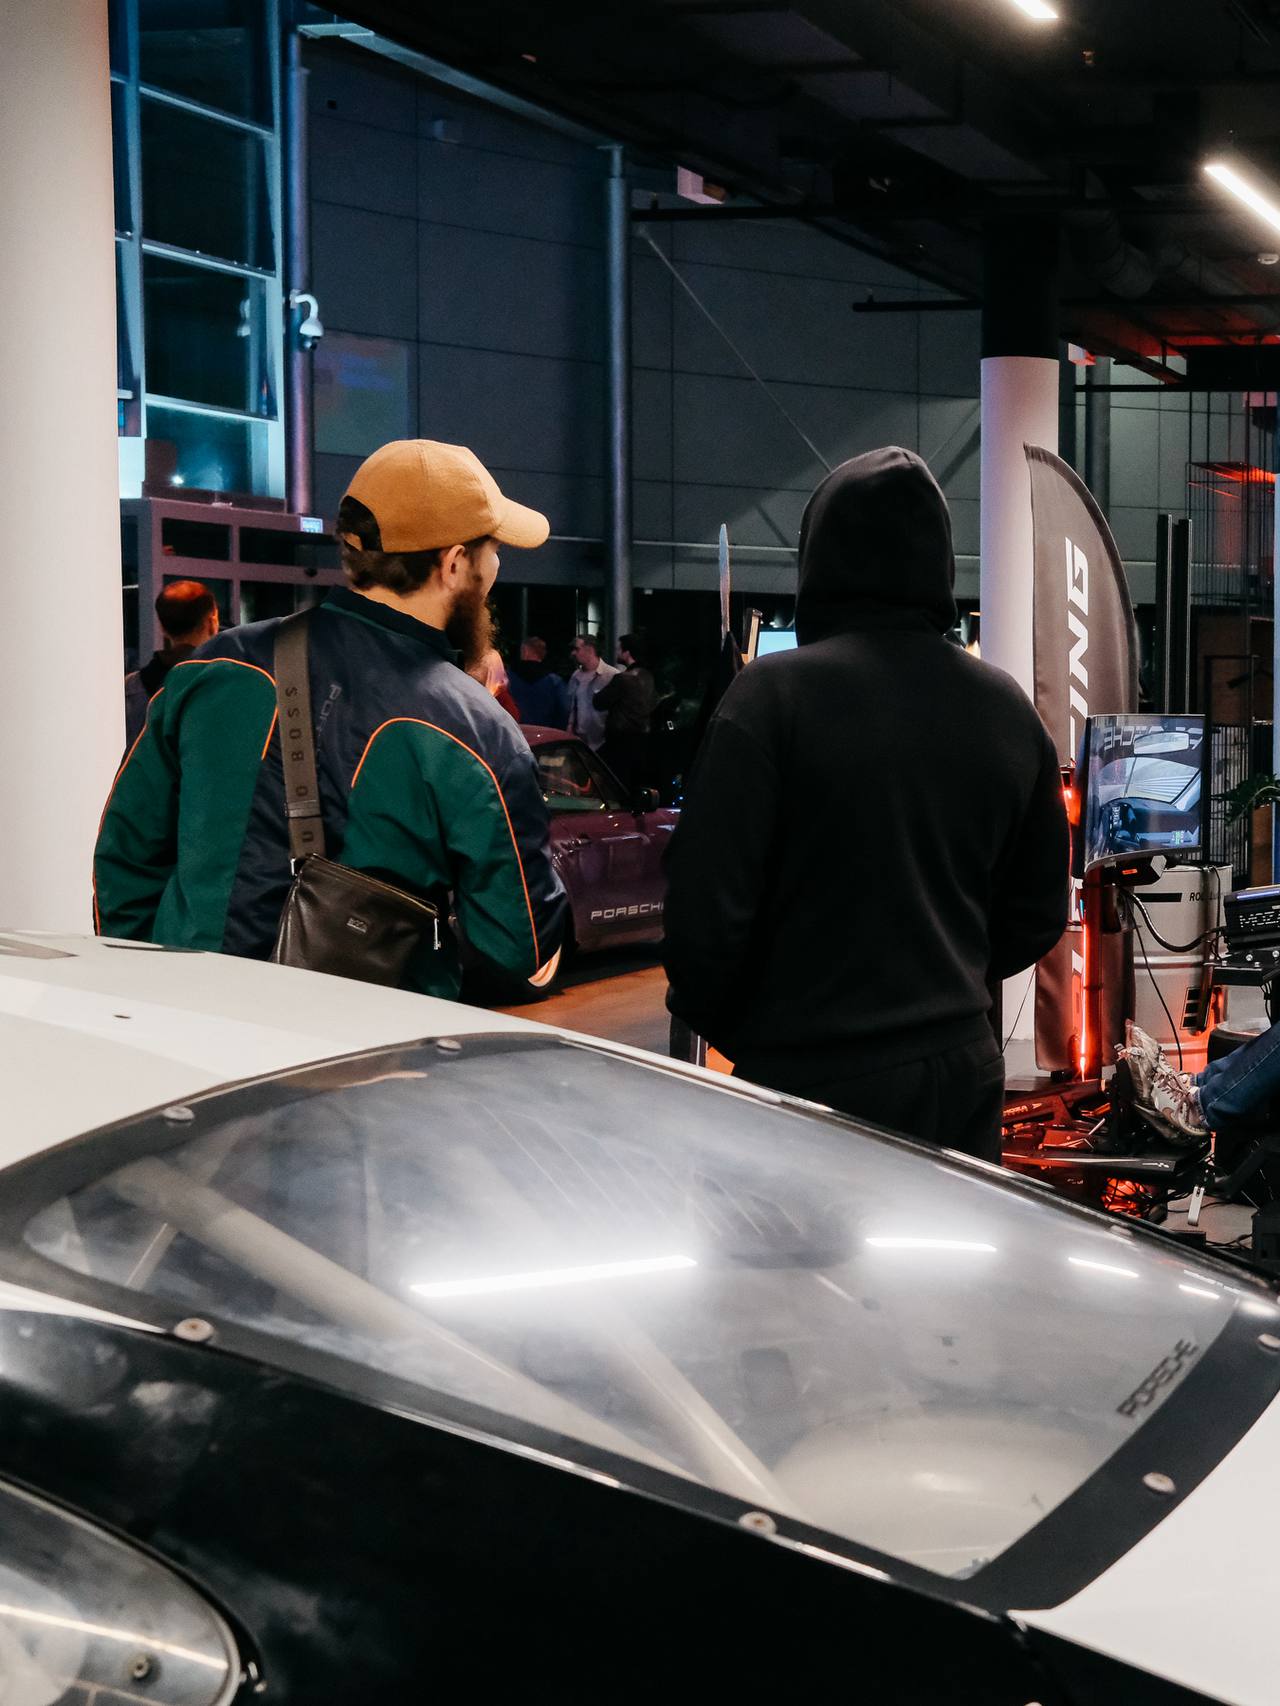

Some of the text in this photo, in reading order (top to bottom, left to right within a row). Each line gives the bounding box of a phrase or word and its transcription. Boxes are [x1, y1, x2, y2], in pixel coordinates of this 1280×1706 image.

[285, 685, 305, 762] BOSS
[590, 902, 664, 920] PORSCH
[1116, 1338, 1198, 1418] PORSCHE
